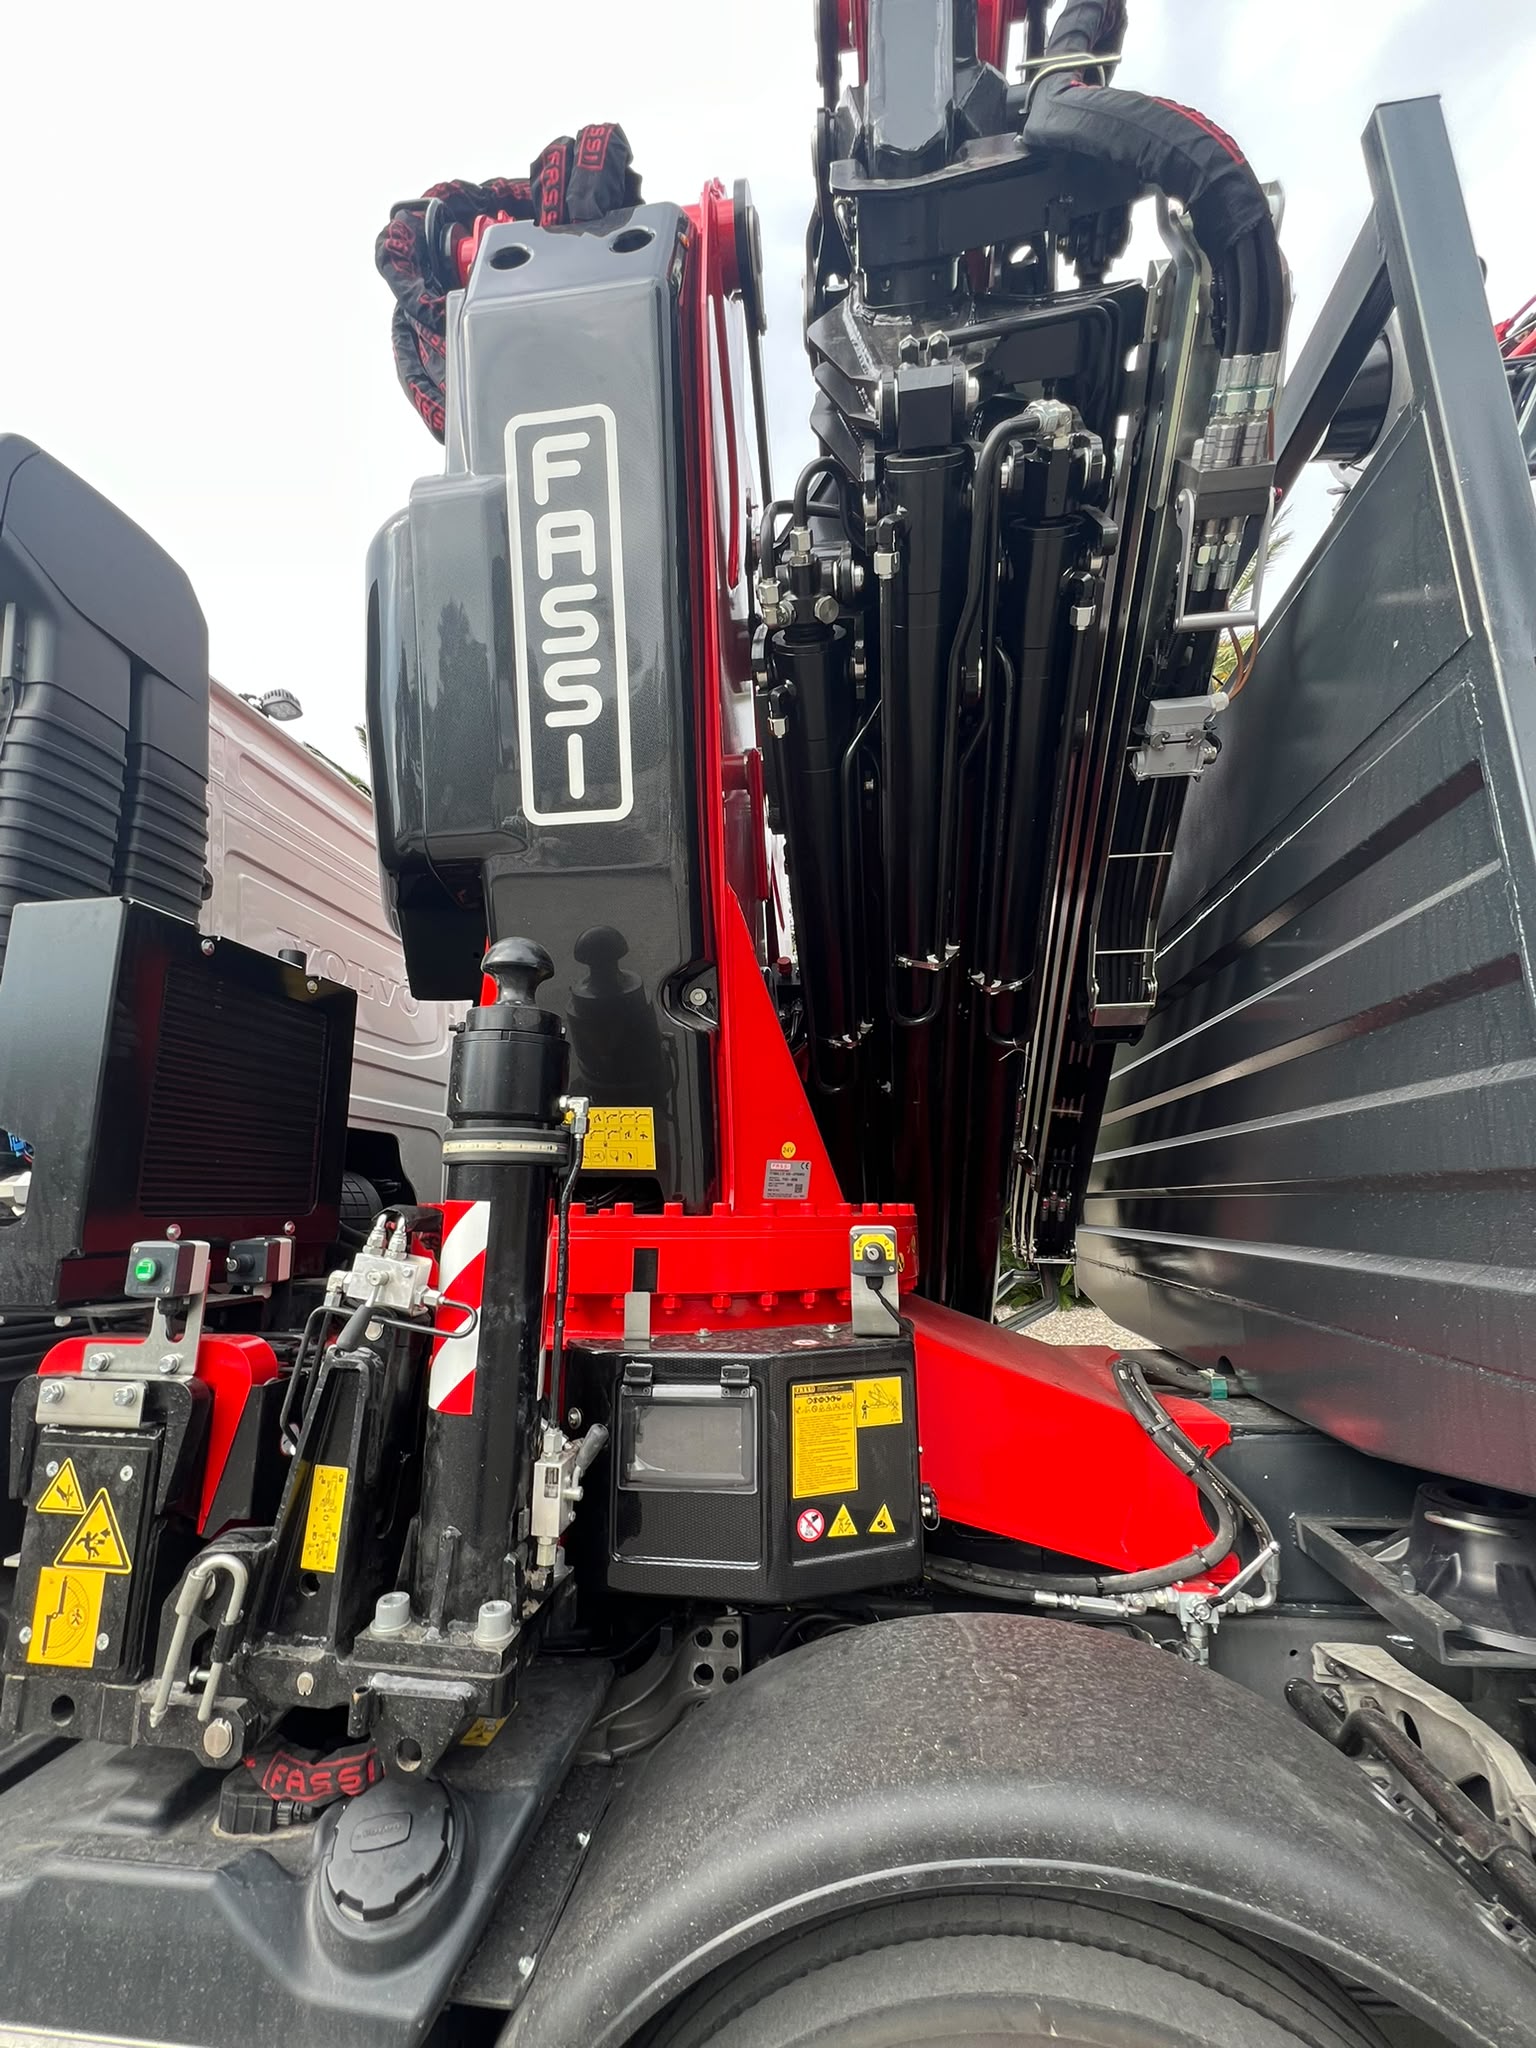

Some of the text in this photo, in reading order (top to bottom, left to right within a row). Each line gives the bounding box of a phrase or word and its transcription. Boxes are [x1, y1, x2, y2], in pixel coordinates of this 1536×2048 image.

[584, 126, 606, 161] SSI
[542, 151, 560, 227] FASS
[532, 432, 603, 800] FASSI
[270, 1759, 375, 1796] FASSI
